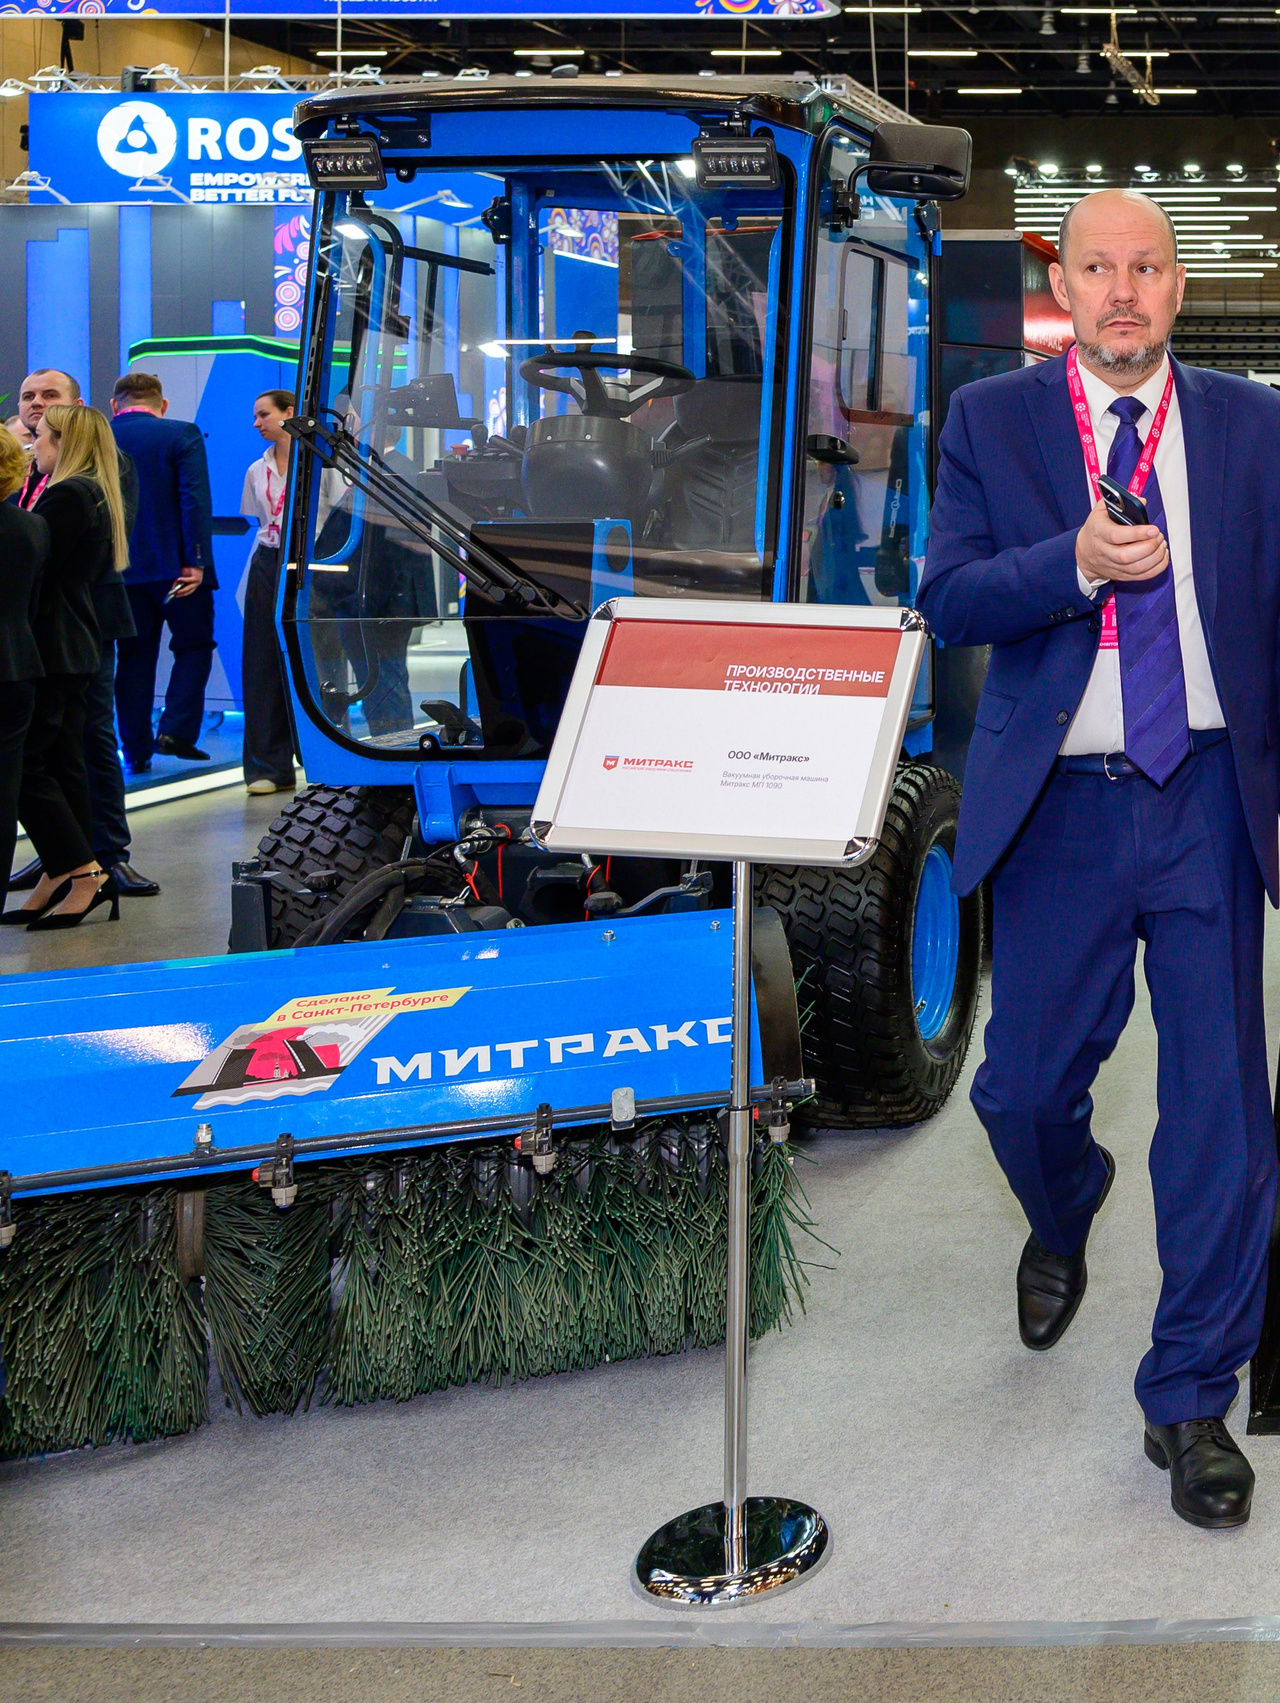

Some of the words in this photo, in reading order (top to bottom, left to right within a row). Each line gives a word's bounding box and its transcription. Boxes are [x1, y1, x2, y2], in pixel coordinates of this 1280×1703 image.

[190, 188, 275, 202] BETTER
[726, 664, 886, 683] ПРОИЗВОДСТВЕННЫЕ
[723, 680, 821, 696] ТЕХНОЛОГИИ
[623, 757, 694, 769] МИТРАКС
[727, 750, 752, 760] ООО
[753, 751, 810, 764] «Митракс»
[720, 779, 750, 788] Митракс
[722, 770, 761, 779] Вакуумная
[762, 772, 799, 781] уборочная
[800, 775, 829, 783] машина
[276, 1013, 287, 1022] в
[291, 993, 449, 1021] Санкт-Петербурге
[296, 993, 372, 1008] Сделано
